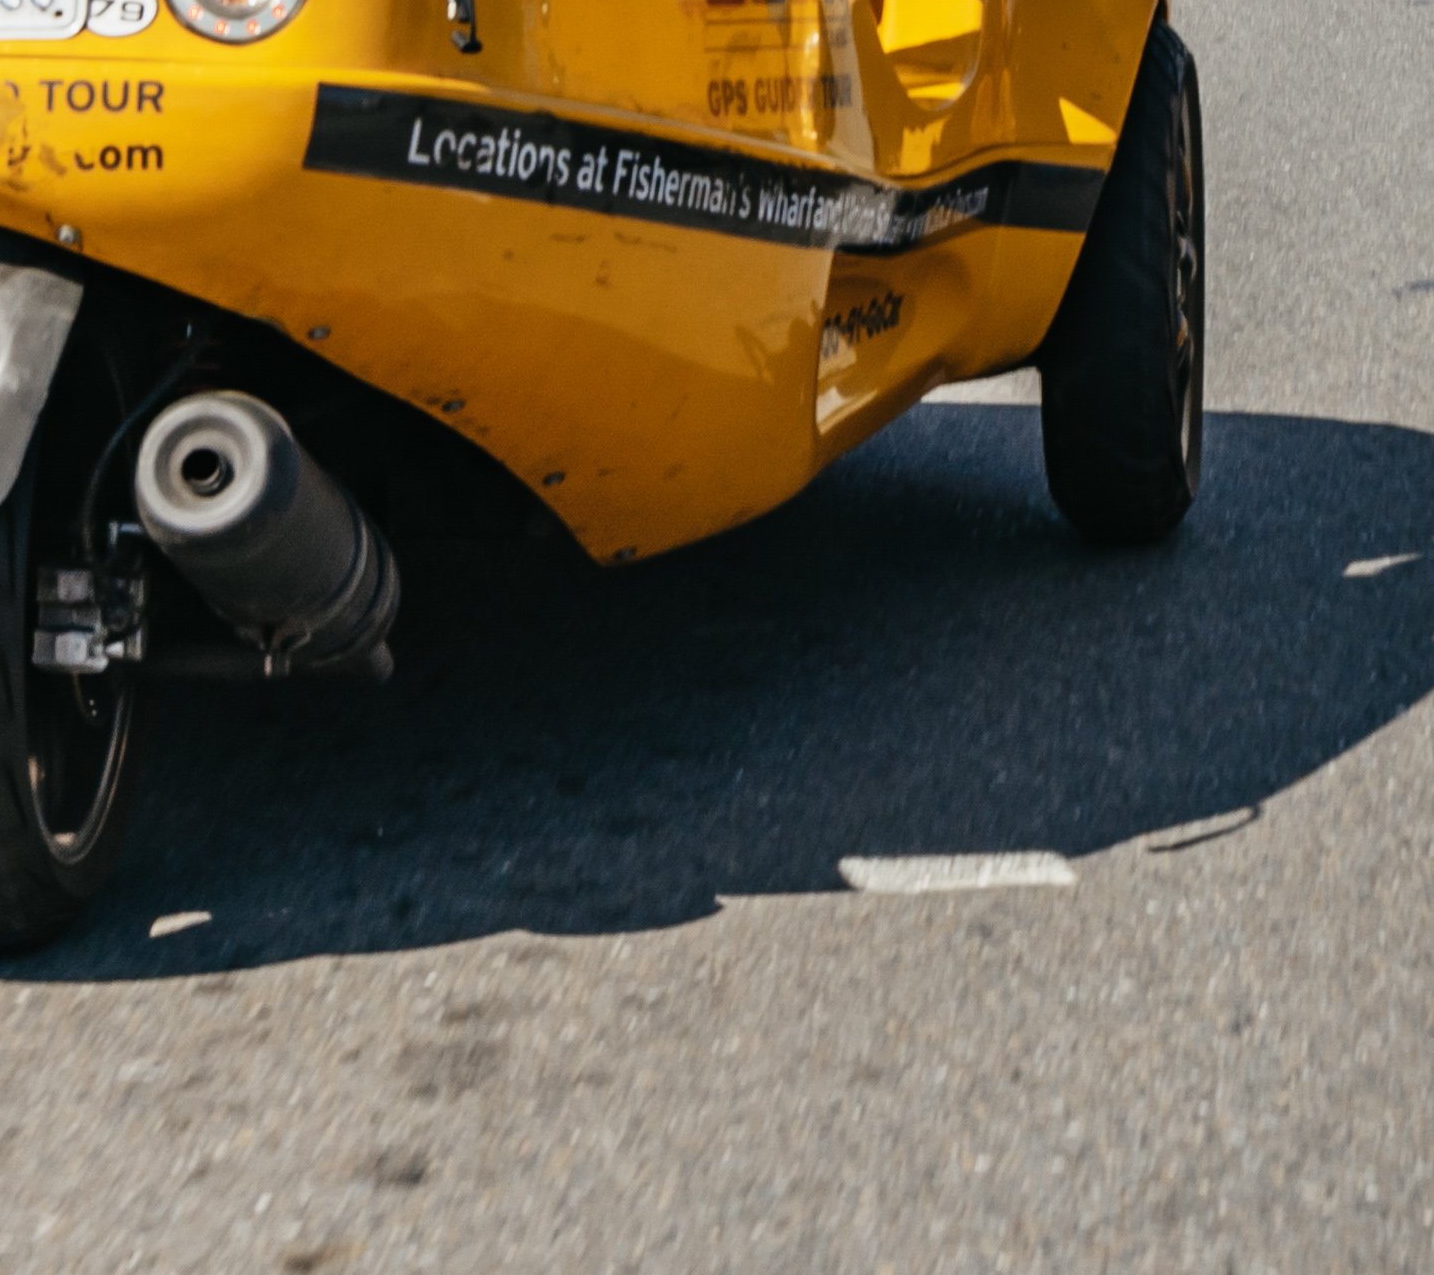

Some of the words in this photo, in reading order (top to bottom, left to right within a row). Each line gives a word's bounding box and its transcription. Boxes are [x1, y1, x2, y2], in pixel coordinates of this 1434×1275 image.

[40, 80, 165, 113] TOUR
[707, 78, 749, 117] GPS
[408, 117, 571, 187] Locations
[577, 146, 609, 193] at
